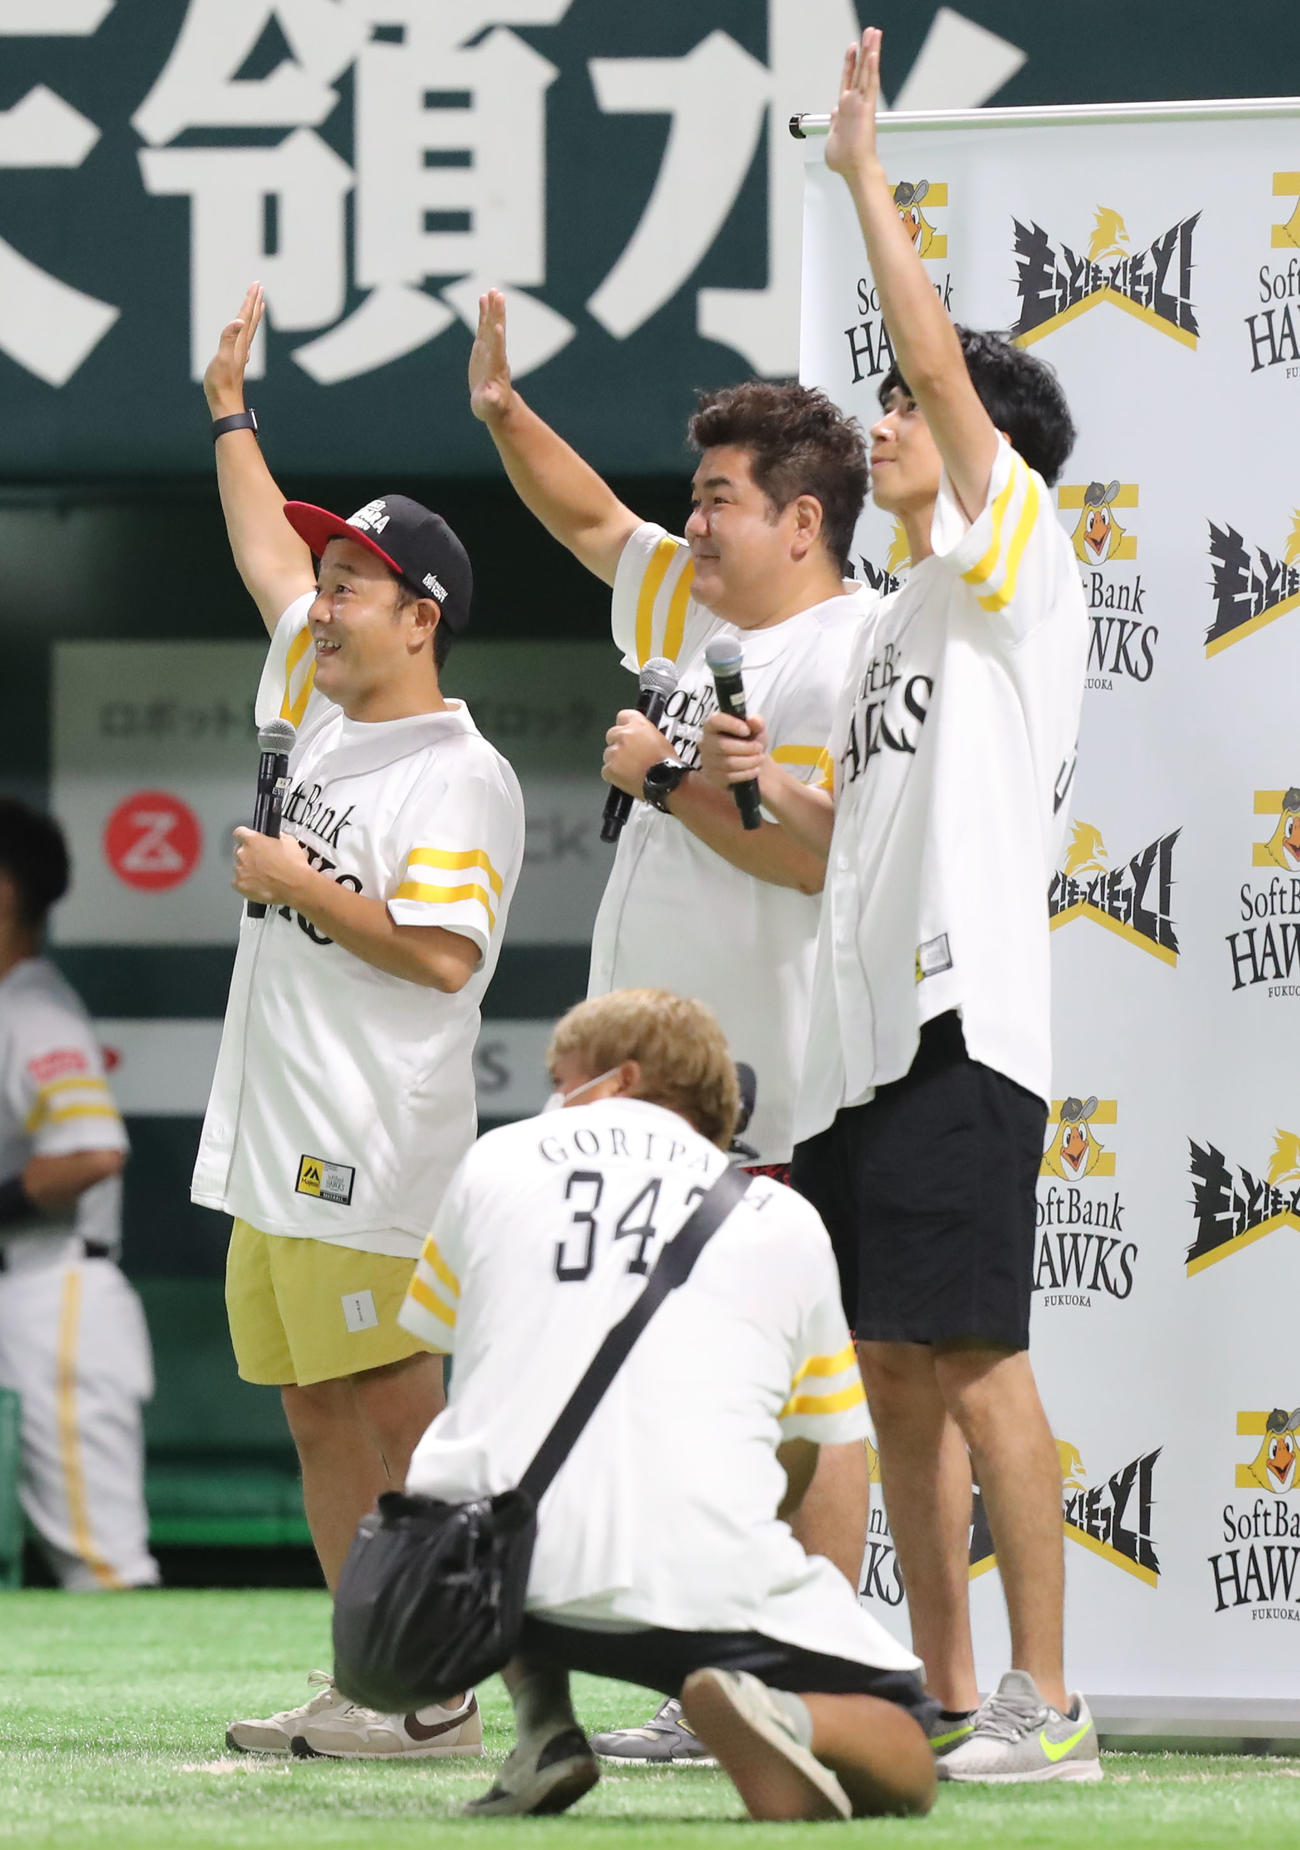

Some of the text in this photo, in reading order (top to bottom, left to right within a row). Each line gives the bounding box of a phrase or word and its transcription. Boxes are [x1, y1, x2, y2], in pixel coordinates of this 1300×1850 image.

[0, 0, 1027, 387] 領水
[1259, 258, 1300, 303] Sof
[1244, 303, 1300, 373] HA
[1083, 572, 1146, 615] Bank
[1087, 616, 1159, 682] WKS
[1036, 1186, 1125, 1232] oftBank
[1032, 1230, 1138, 1299] AWKS
[1044, 1294, 1092, 1307] FUKUOKA
[1208, 1543, 1300, 1613] HAW
